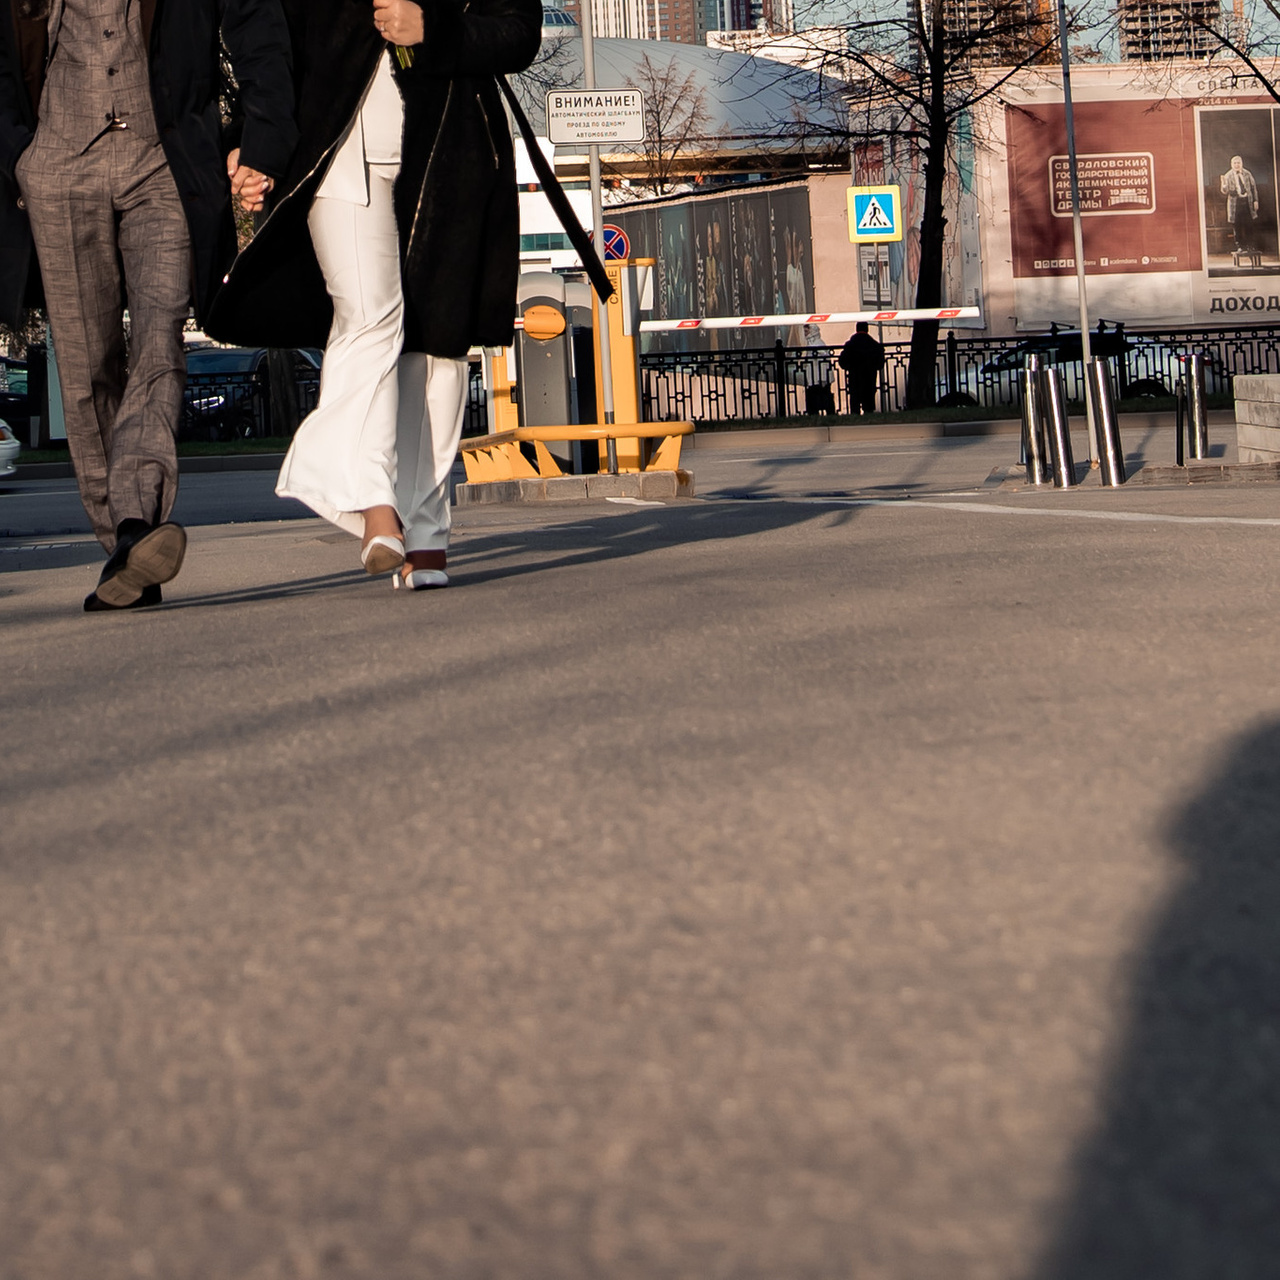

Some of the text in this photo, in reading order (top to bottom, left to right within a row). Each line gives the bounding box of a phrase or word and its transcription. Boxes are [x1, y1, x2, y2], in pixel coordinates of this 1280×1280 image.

[554, 95, 635, 108] ВНИМАНИЕ!
[1055, 158, 1148, 170] СВРДЛОВСКИЙ
[1056, 176, 1148, 188] АКДЕМИЧЕСКИЙ
[1057, 200, 1102, 210] ДРМЫ
